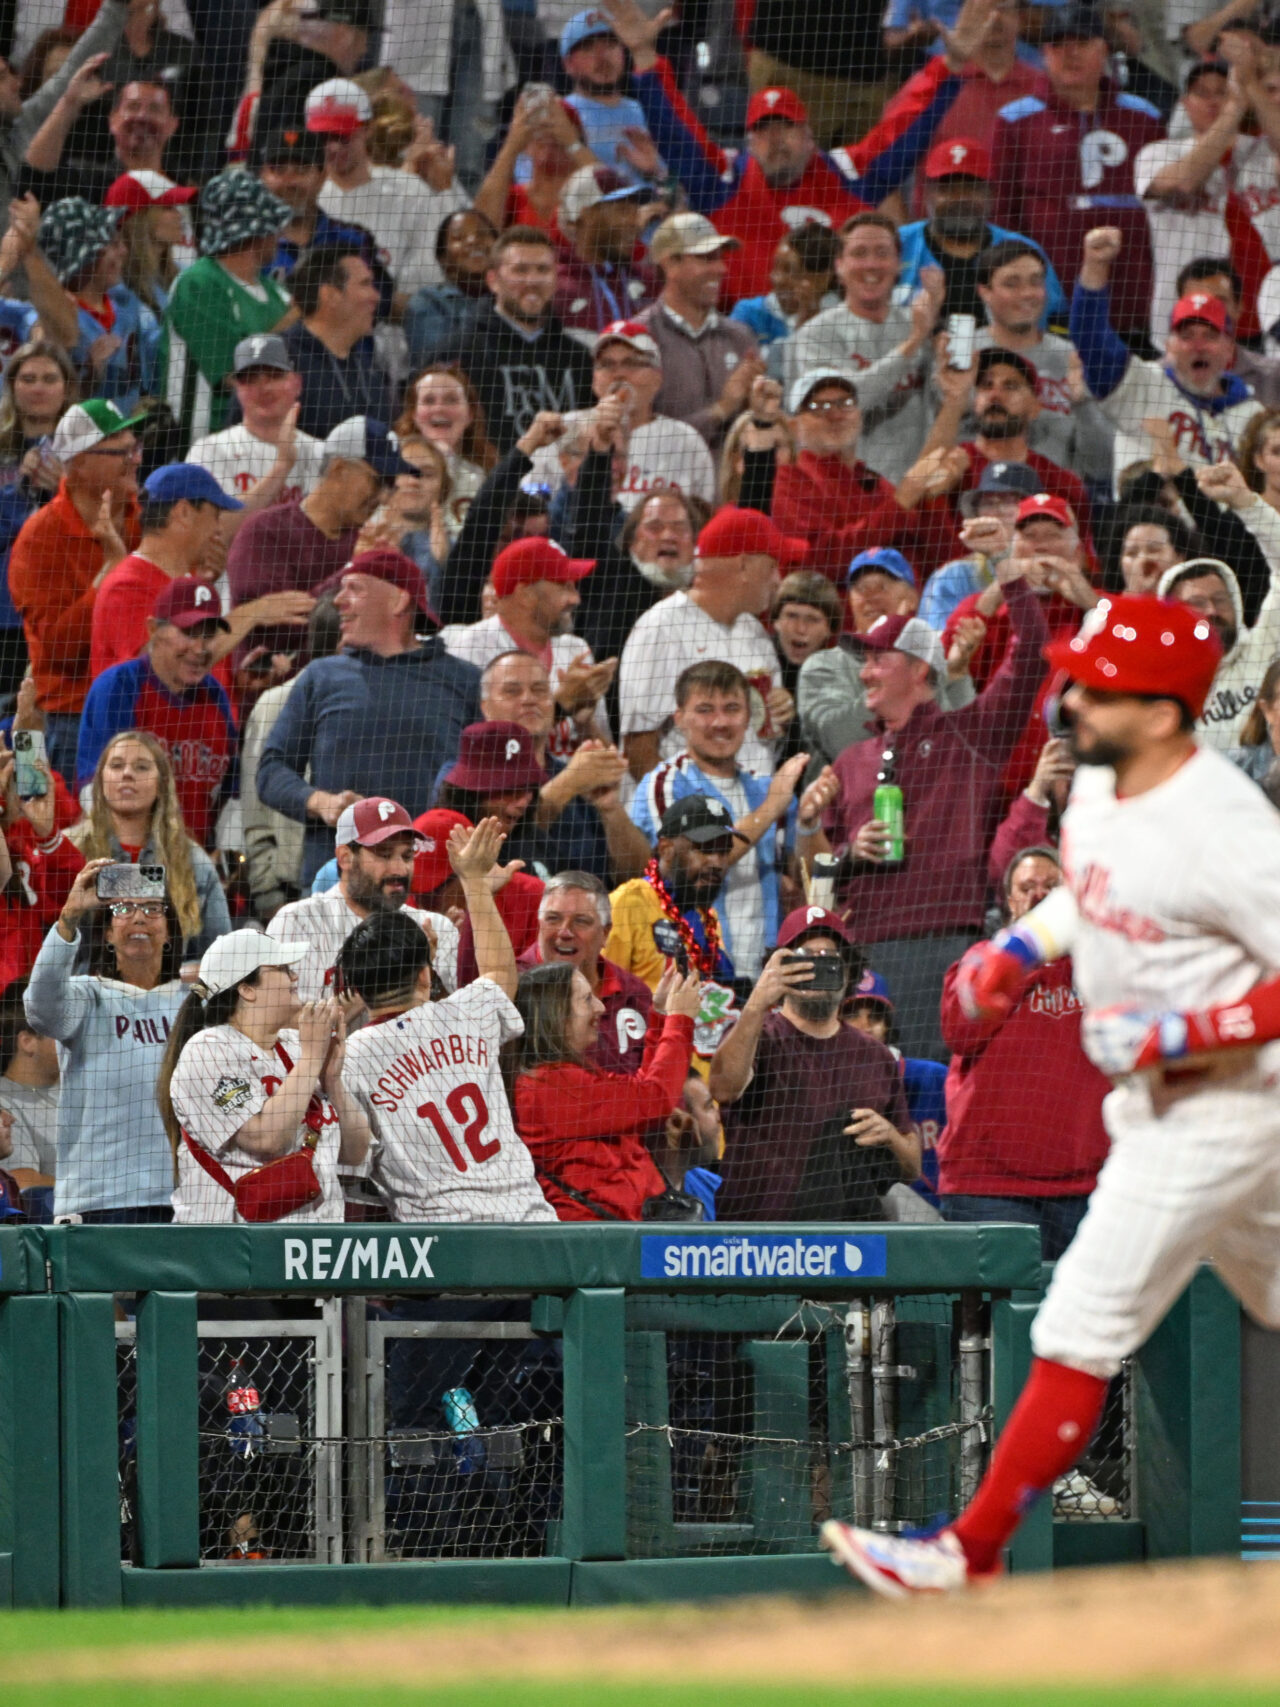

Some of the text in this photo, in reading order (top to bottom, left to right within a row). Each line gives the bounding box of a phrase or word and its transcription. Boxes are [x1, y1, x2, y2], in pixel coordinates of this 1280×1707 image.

[1079, 129, 1129, 189] P
[194, 585, 212, 607] P
[505, 739, 520, 761] P
[377, 801, 396, 822] P
[806, 905, 827, 925] P
[615, 1007, 648, 1055] P
[370, 1034, 490, 1113] SCHWARBER
[417, 1081, 502, 1172] 12
[284, 1237, 436, 1280] RE/MAX
[663, 1237, 838, 1277] smartwater
